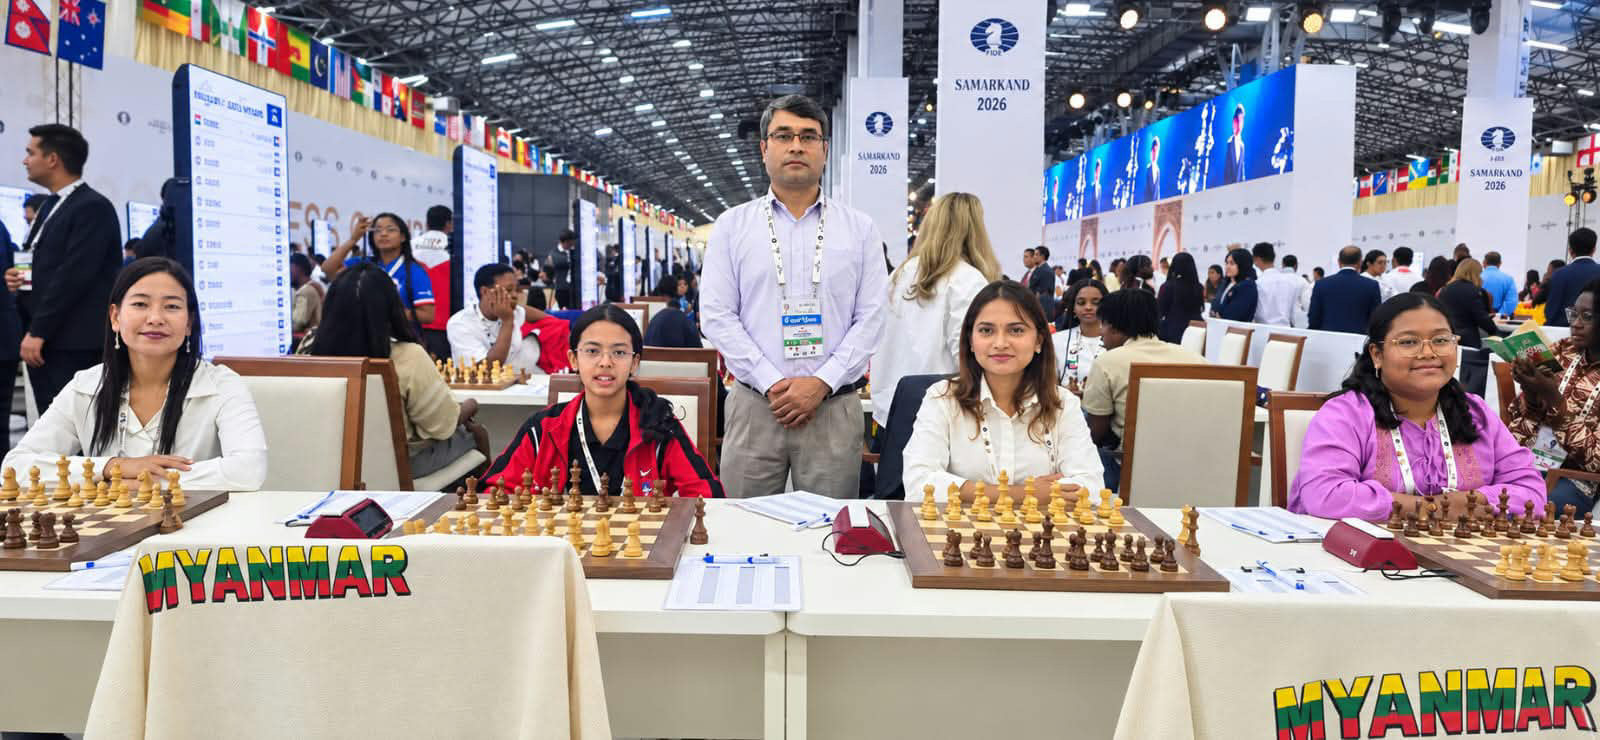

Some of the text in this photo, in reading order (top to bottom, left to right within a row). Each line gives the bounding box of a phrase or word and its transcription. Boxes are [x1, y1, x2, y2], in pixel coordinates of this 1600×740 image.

[954, 79, 1030, 91] SAMARKAND
[977, 97, 1007, 111] 2026
[857, 152, 901, 161] SAMARKAND
[869, 164, 888, 175] 2026
[1470, 168, 1523, 178] SAMARKAND
[1484, 180, 1506, 191] 2026
[138, 545, 411, 615] MYANMAR
[1273, 665, 1598, 740] MYANMAR
